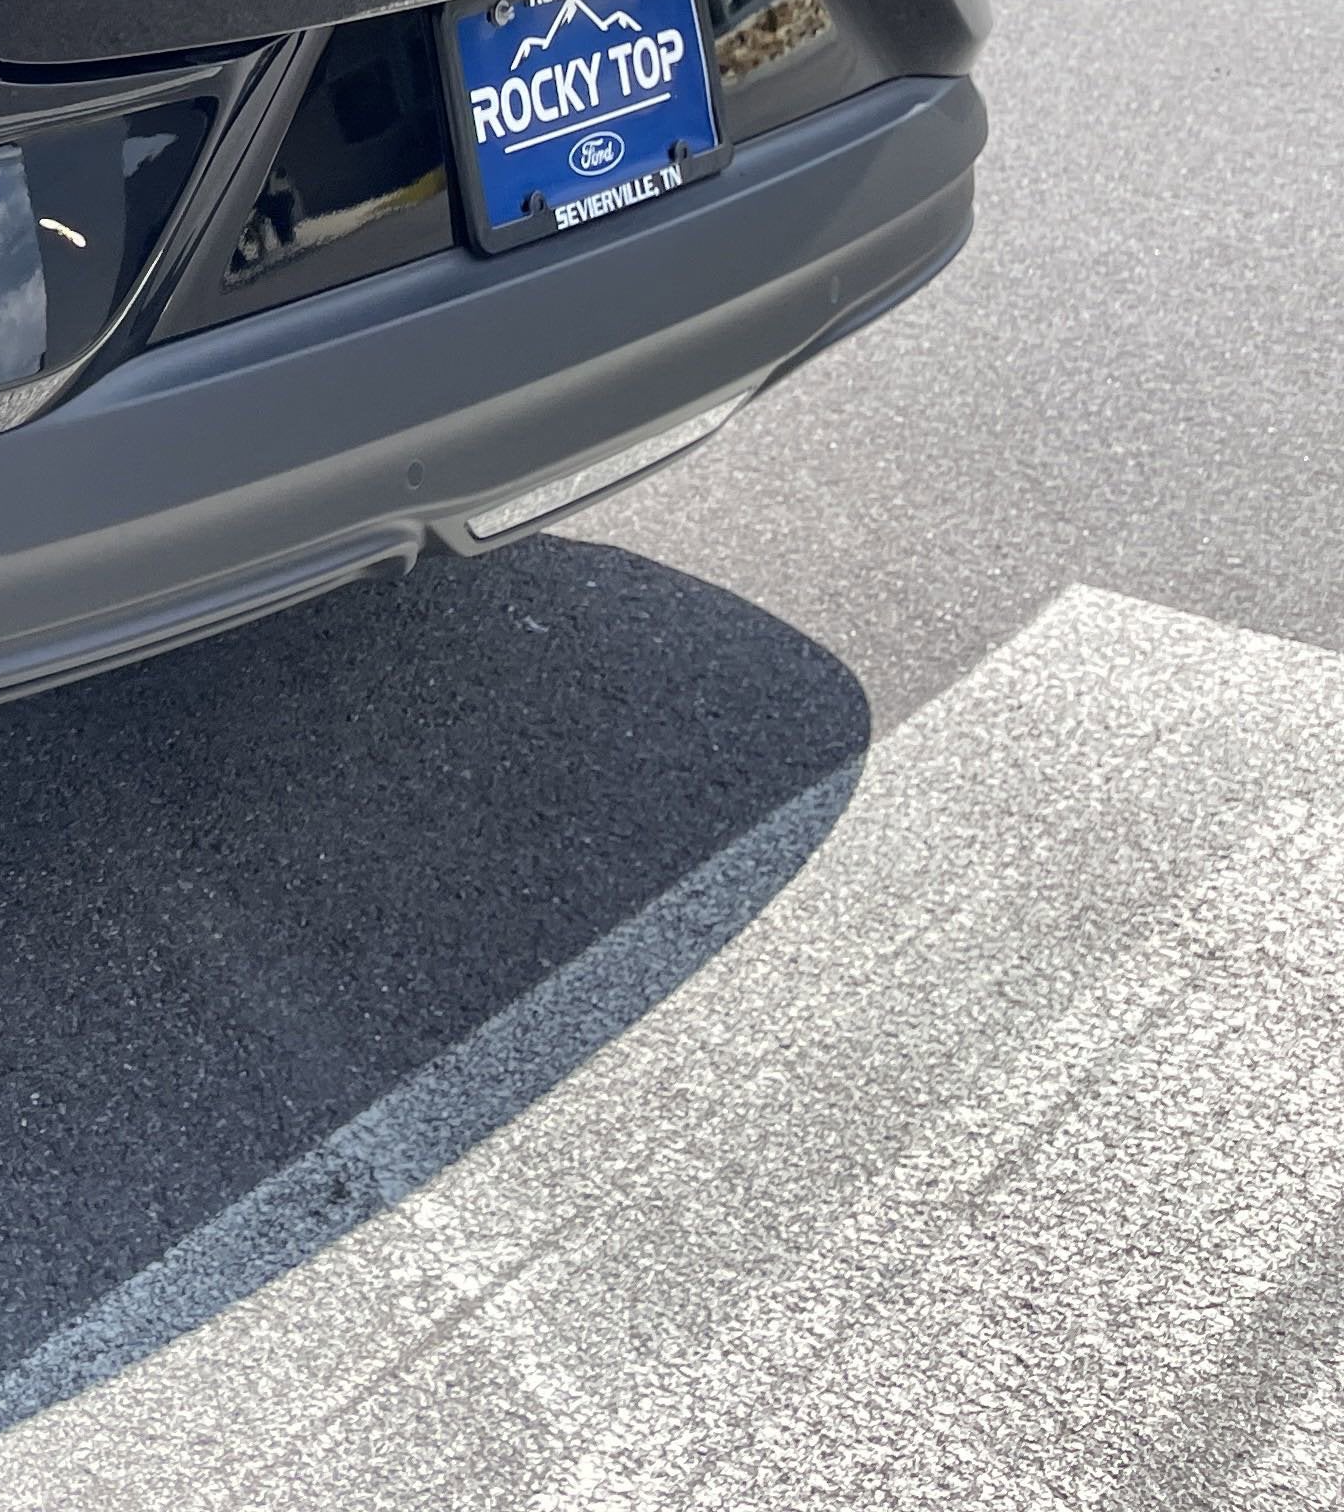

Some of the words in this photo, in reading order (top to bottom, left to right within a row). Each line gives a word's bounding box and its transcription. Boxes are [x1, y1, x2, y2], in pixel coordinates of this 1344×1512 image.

[470, 51, 602, 144] ROCKY
[608, 28, 685, 96] TOP
[580, 139, 615, 169] Ford
[555, 176, 660, 230] SEVIERVILLE,
[659, 164, 683, 190] TN
